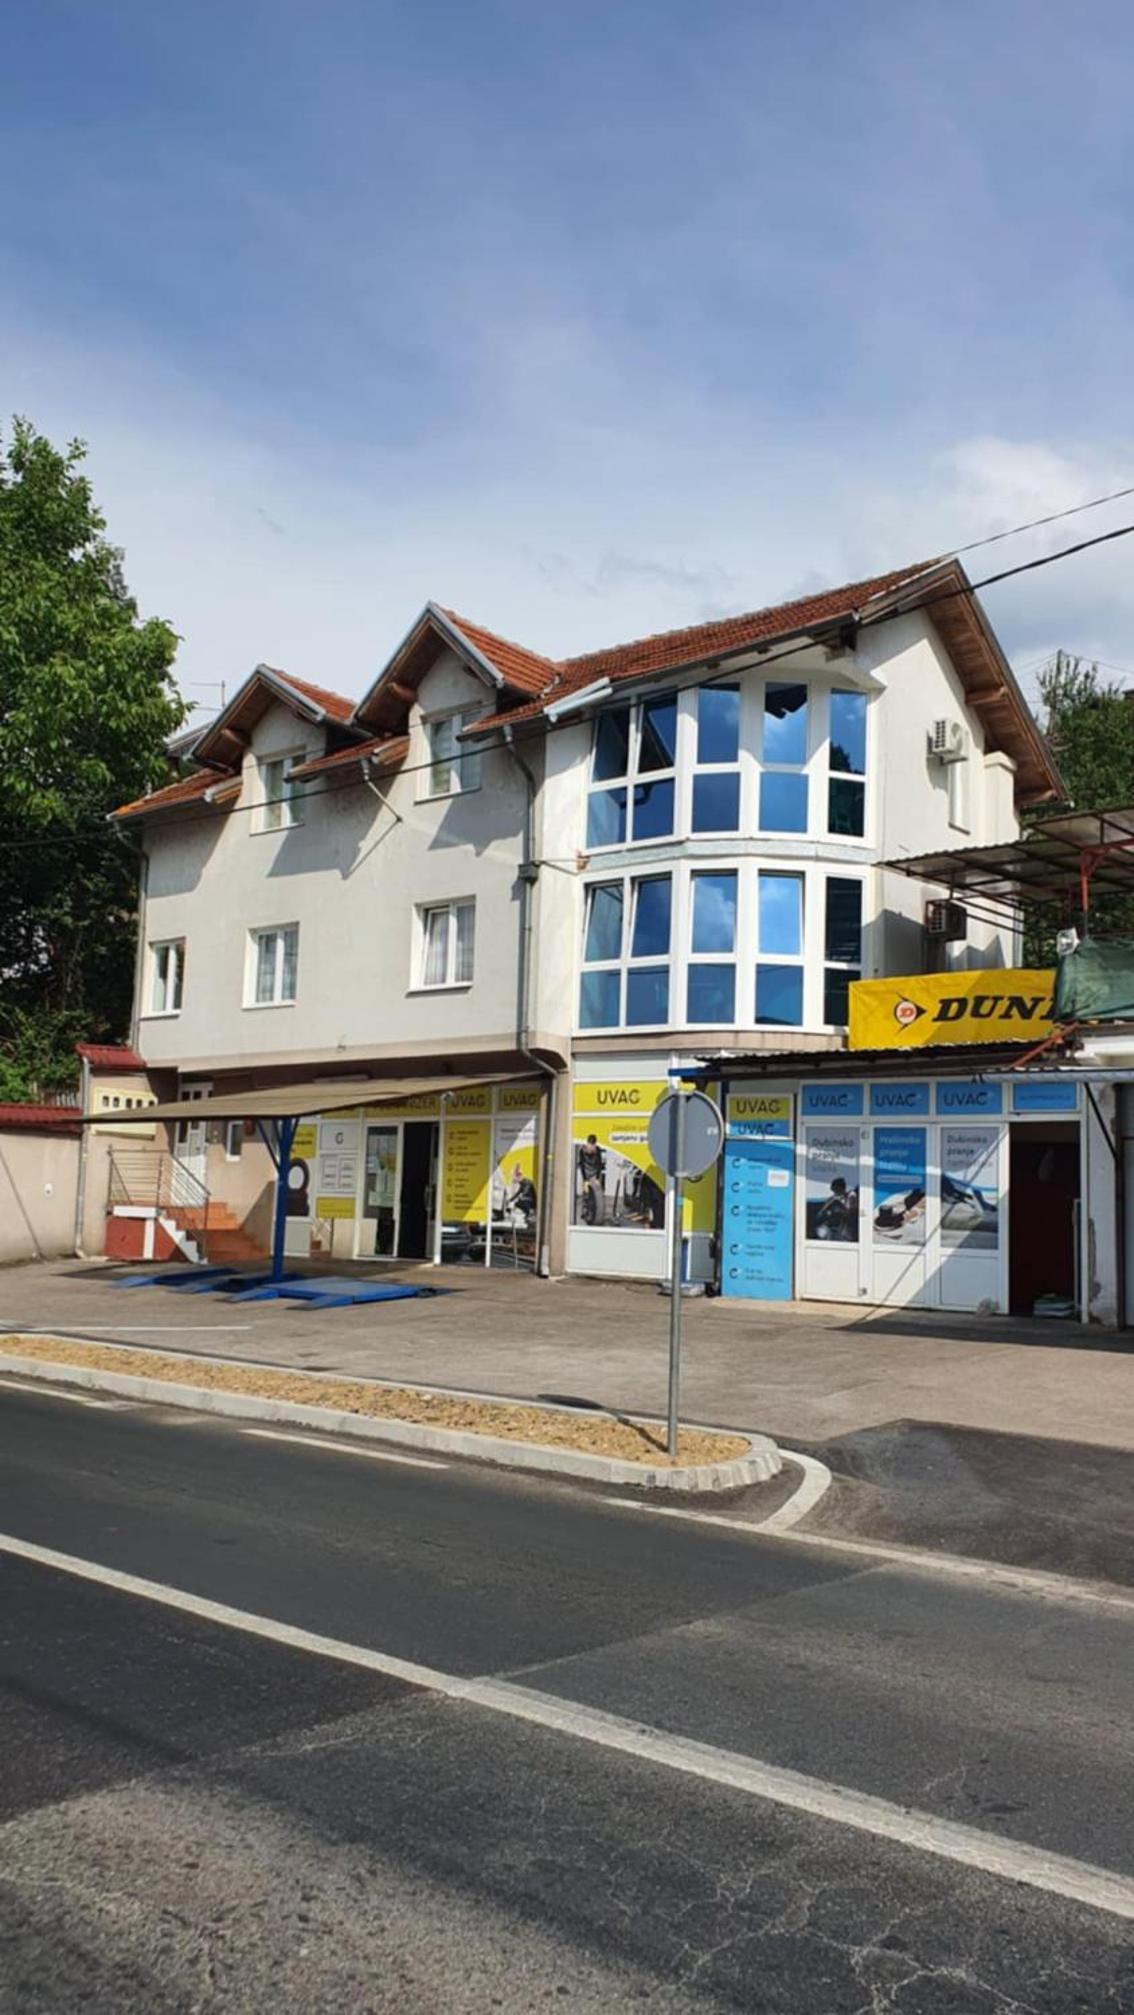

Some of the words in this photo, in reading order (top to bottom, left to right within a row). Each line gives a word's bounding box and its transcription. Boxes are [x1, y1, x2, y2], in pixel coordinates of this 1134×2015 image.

[596, 1088, 641, 1105] UVAC
[808, 1094, 848, 1108] UVAC
[875, 1093, 916, 1107] UVAC
[943, 1092, 987, 1107] UVAC
[736, 1098, 781, 1114] UVAC
[737, 1123, 774, 1136] UVAC
